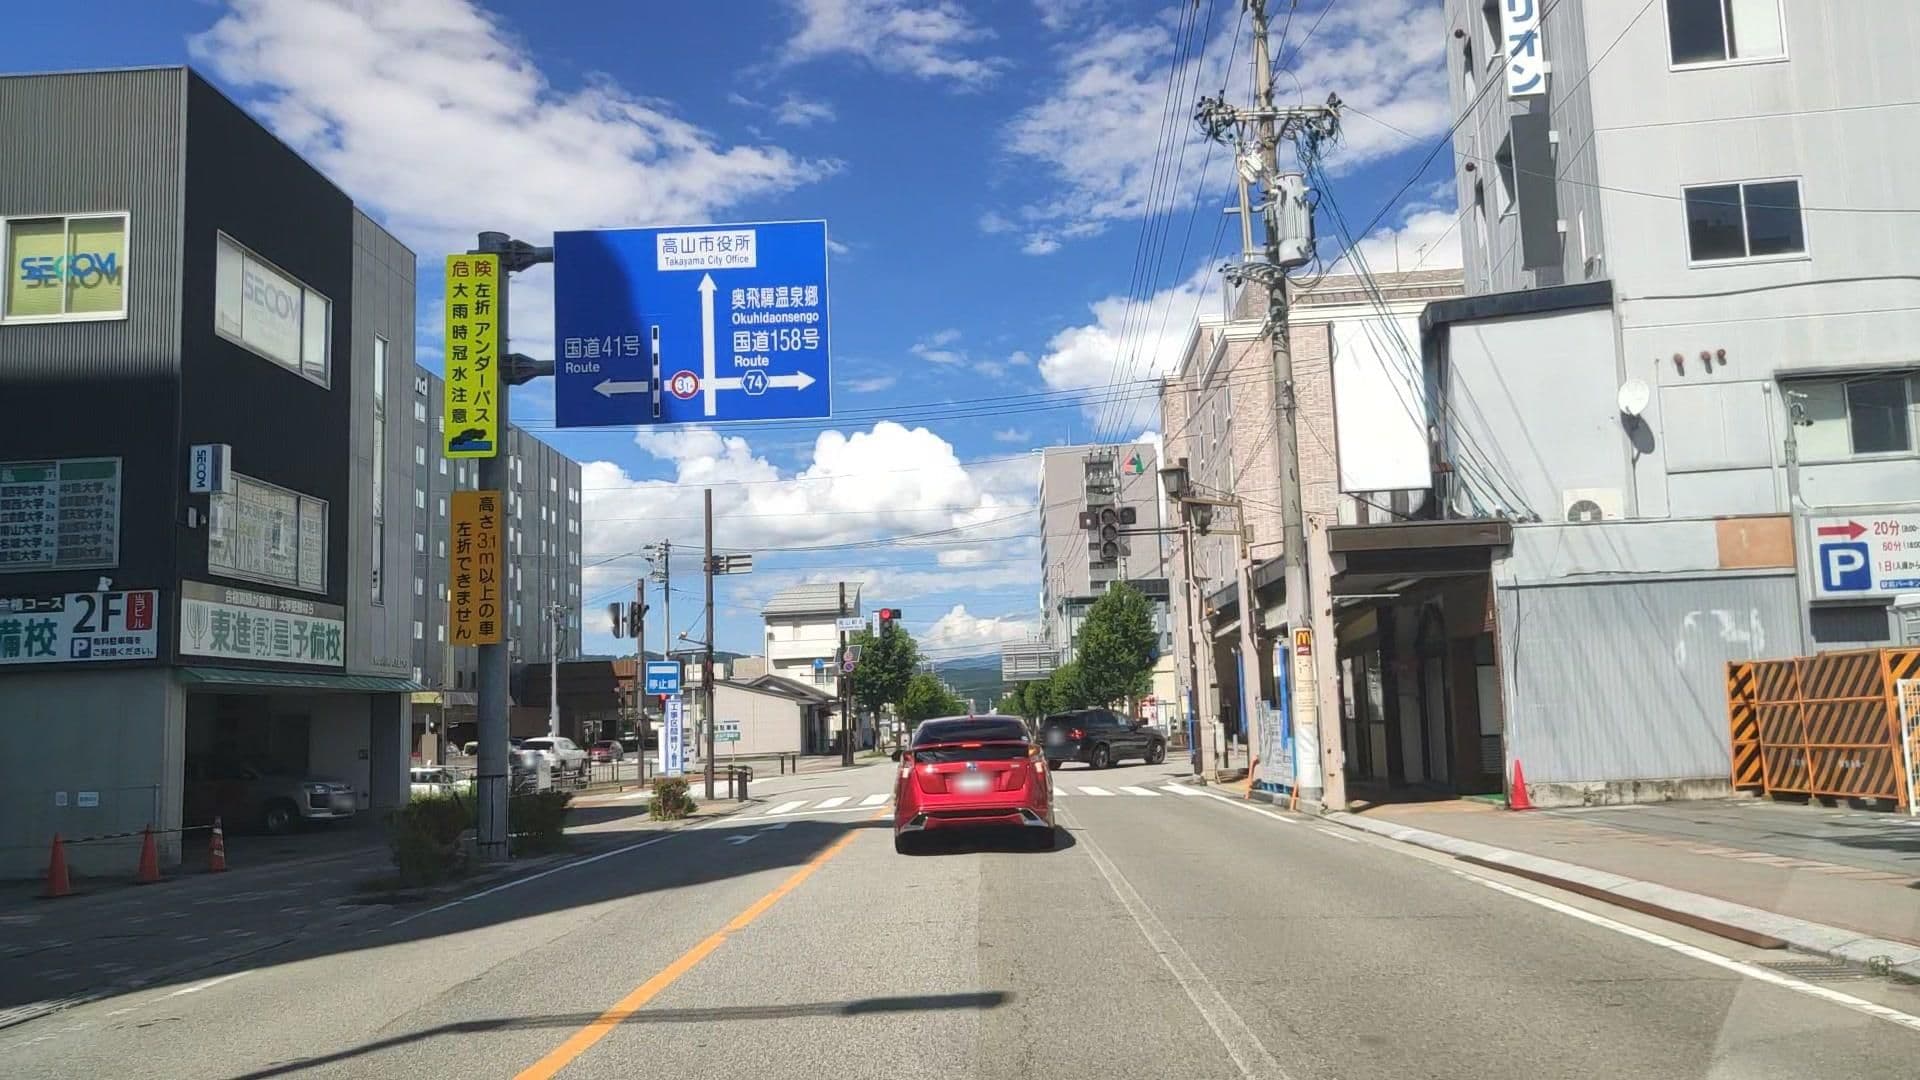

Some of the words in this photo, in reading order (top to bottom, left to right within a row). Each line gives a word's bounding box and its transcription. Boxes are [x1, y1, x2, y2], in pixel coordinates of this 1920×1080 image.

[662, 234, 750, 255] 高山市役所
[21, 253, 116, 280] SECOM
[665, 256, 705, 268] Takayama
[707, 256, 723, 266] City
[725, 254, 749, 265] Office
[564, 335, 641, 359] 国道41号
[733, 328, 820, 353] 国道158号
[451, 283, 468, 424] 大雨時冠水注意
[734, 355, 769, 368] Route
[565, 362, 600, 374] Route
[747, 375, 763, 389] 74
[196, 449, 206, 488] SECOM
[1873, 520, 1900, 536] 20分
[1882, 542, 1901, 551] 60分
[1828, 549, 1865, 586] P
[455, 521, 472, 640] 左折できません
[73, 593, 123, 633] 2F
[210, 608, 341, 662] 東進衛星予備校
